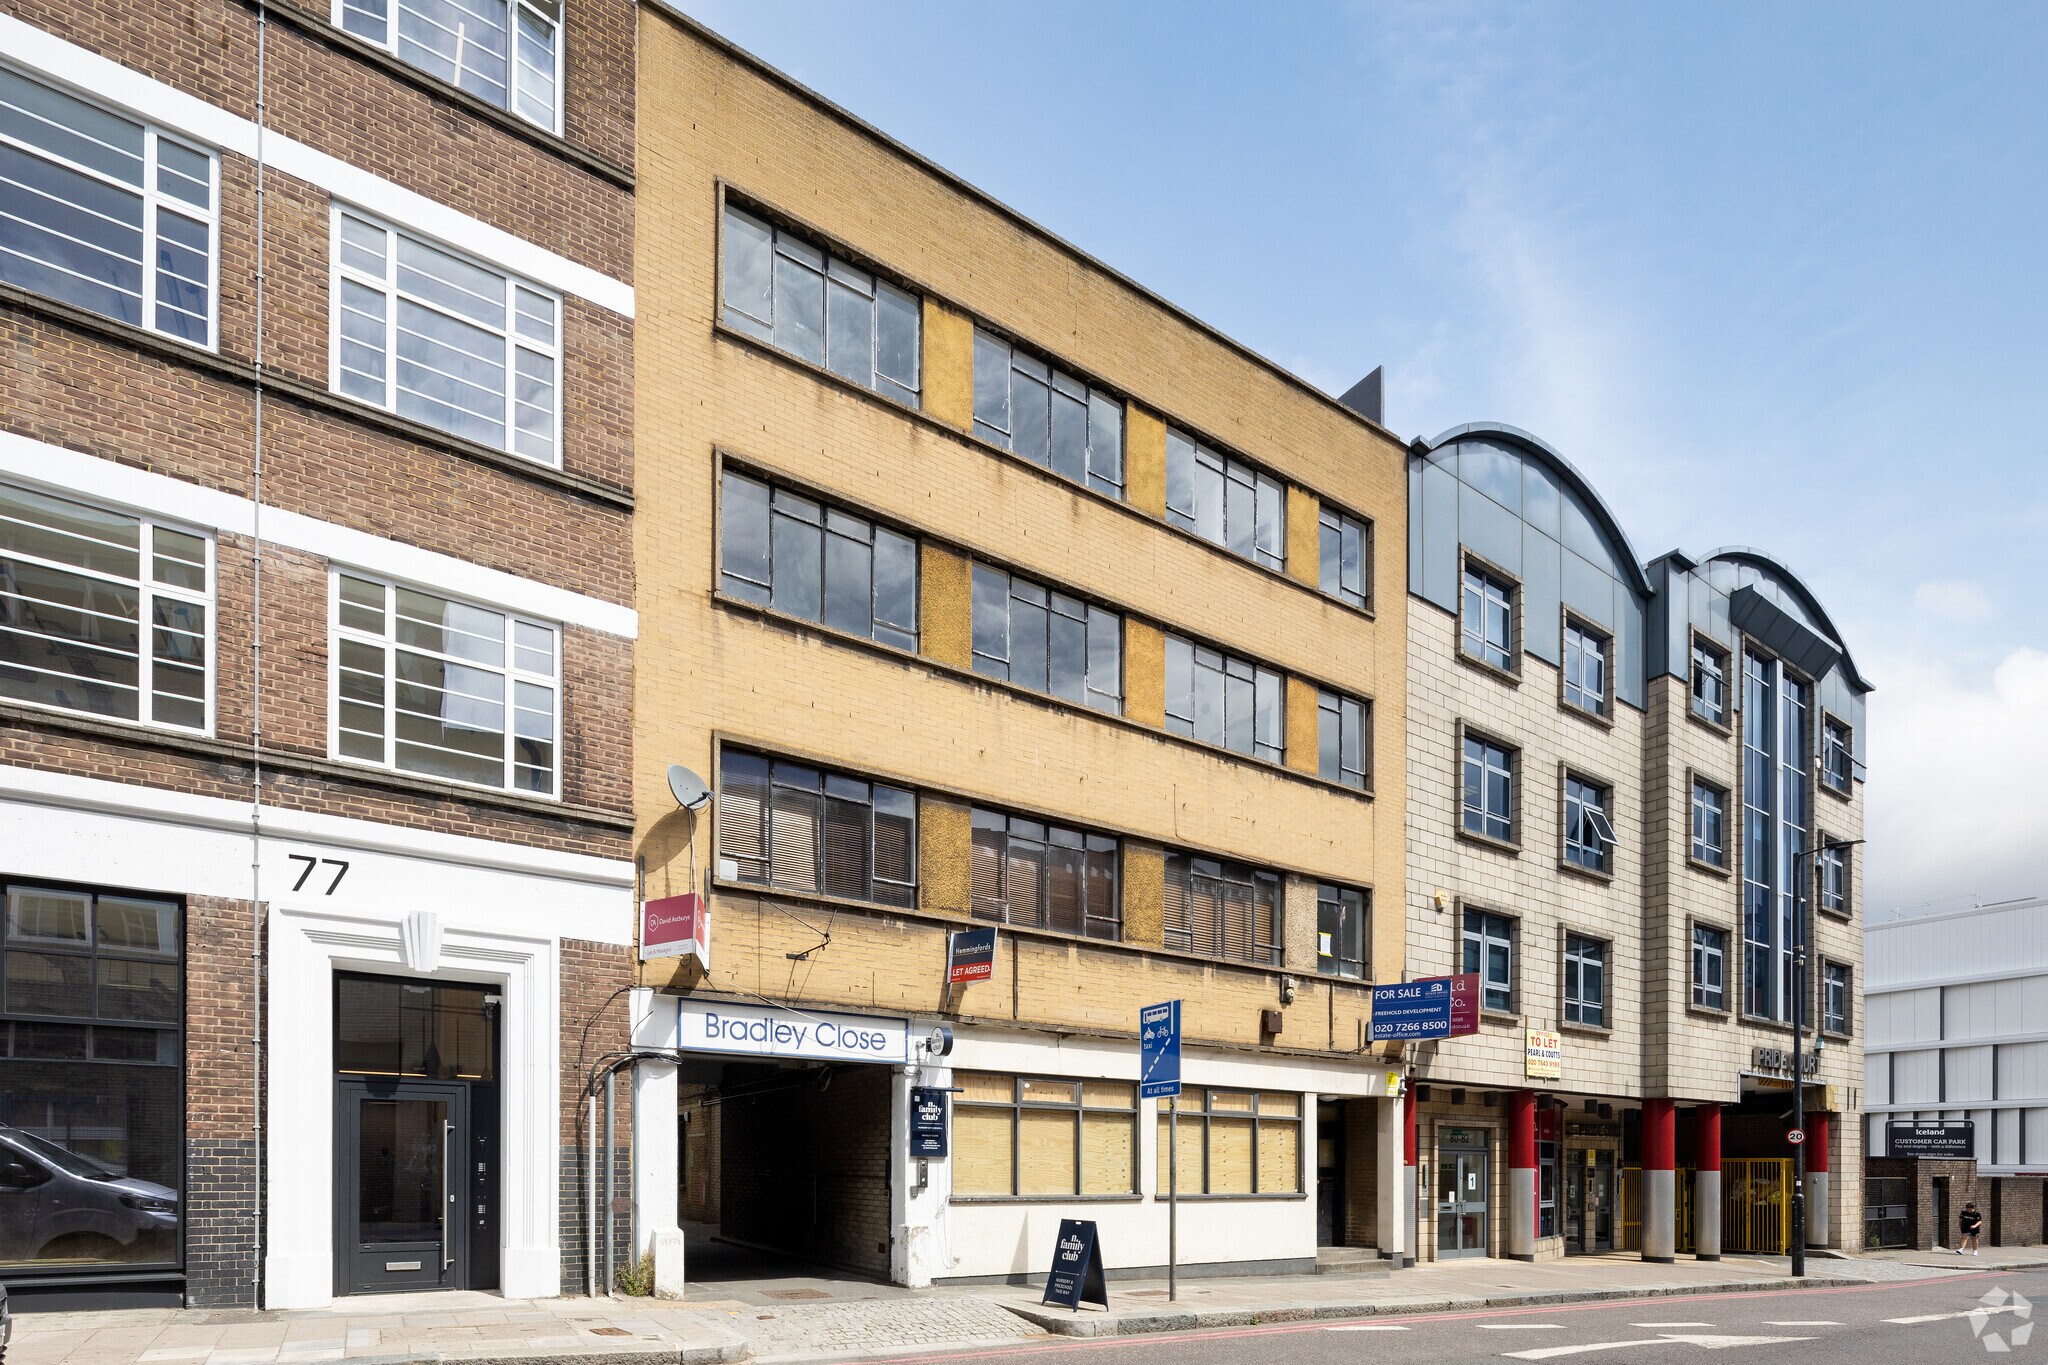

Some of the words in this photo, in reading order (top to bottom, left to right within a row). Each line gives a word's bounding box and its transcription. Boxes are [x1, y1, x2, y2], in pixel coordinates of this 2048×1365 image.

[288, 854, 349, 896] 77
[956, 943, 990, 954] Hemmingfords
[952, 968, 963, 976] LET
[964, 965, 990, 975] AGREED
[1375, 990, 1395, 1000] FOR
[1398, 988, 1421, 998] SALE
[706, 1013, 807, 1049] Bradley
[815, 1023, 886, 1050] Close
[1375, 1024, 1393, 1032] 020
[1396, 1022, 1420, 1031] 7266
[1422, 1021, 1447, 1030] 8500
[1375, 1031, 1421, 1040] estate-office.com
[1531, 1037, 1541, 1046] TO
[1544, 1038, 1558, 1048] LET
[1528, 1049, 1540, 1057] PEARL
[1546, 1051, 1560, 1059] COUTTS
[1758, 1048, 1786, 1069] PRIDE
[1790, 1053, 1820, 1073] CURT
[919, 1105, 942, 1115] family
[922, 1112, 938, 1120] club
[1450, 1133, 1469, 1143] 80-82
[1470, 1177, 1474, 1187] 1
[1571, 1187, 1574, 1195] 2
[1060, 1239, 1085, 1253] family
[1062, 1251, 1078, 1261] club
